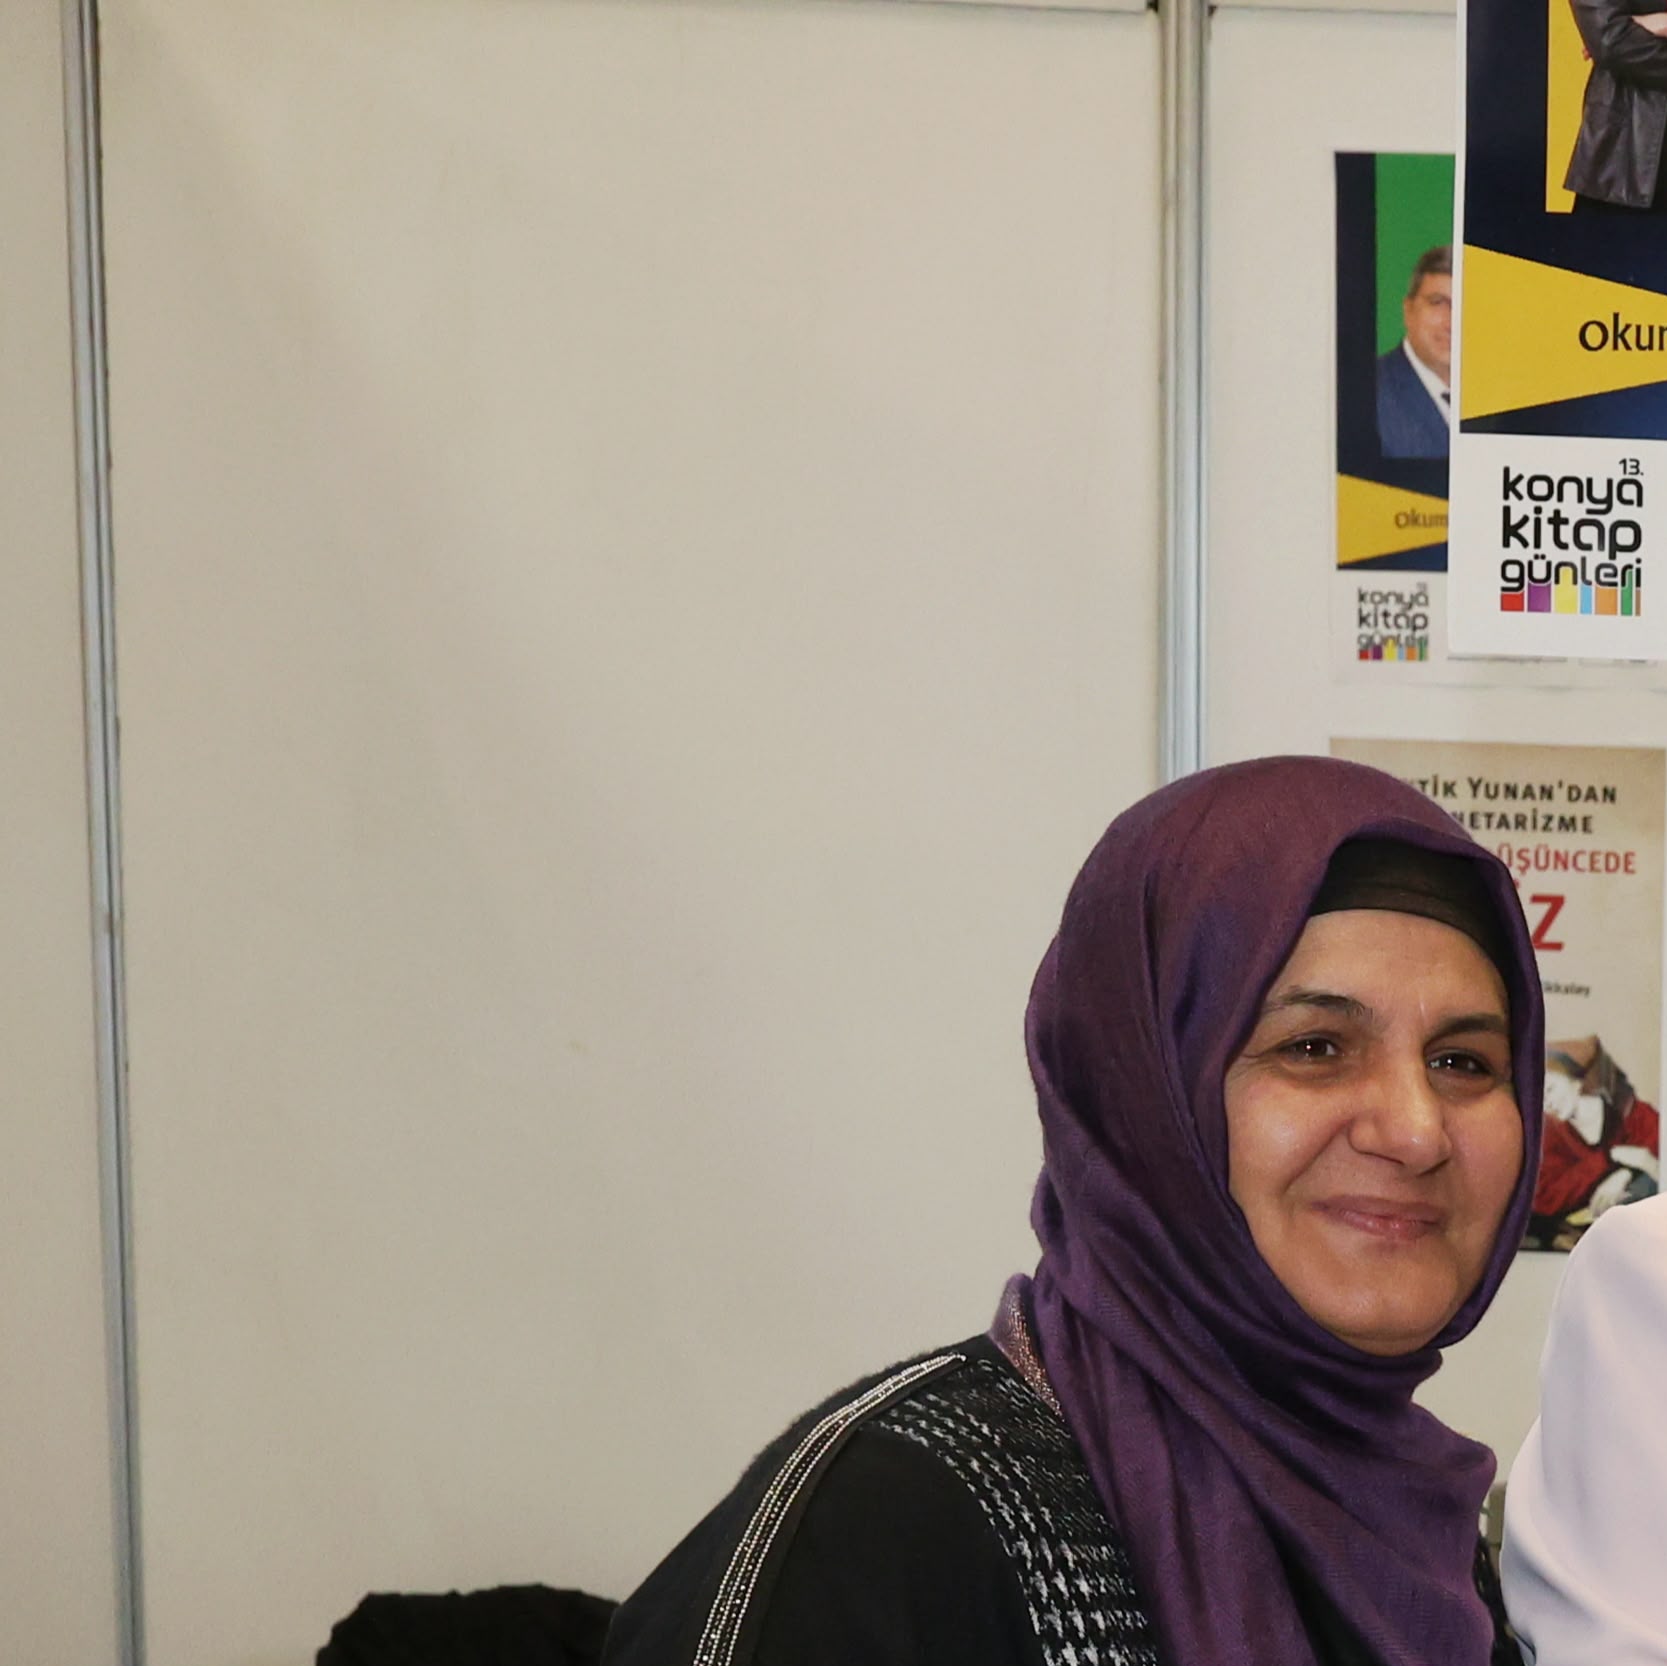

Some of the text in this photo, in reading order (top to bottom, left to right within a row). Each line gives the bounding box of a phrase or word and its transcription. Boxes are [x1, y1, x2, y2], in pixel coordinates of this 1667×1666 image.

[1618, 458, 1645, 477] 13.
[1502, 465, 1645, 516] konya
[1394, 509, 1448, 530] okum
[1501, 505, 1643, 560] kitap
[1500, 554, 1643, 593] günleri
[1357, 586, 1430, 613] konya
[1357, 607, 1429, 635] kitap
[1409, 774, 1618, 805] TİK YUNAN'DAN
[1452, 808, 1594, 834] NETARİZME
[1496, 842, 1637, 876] ÜŞÜNCEDE
[1529, 893, 1567, 952] Z
